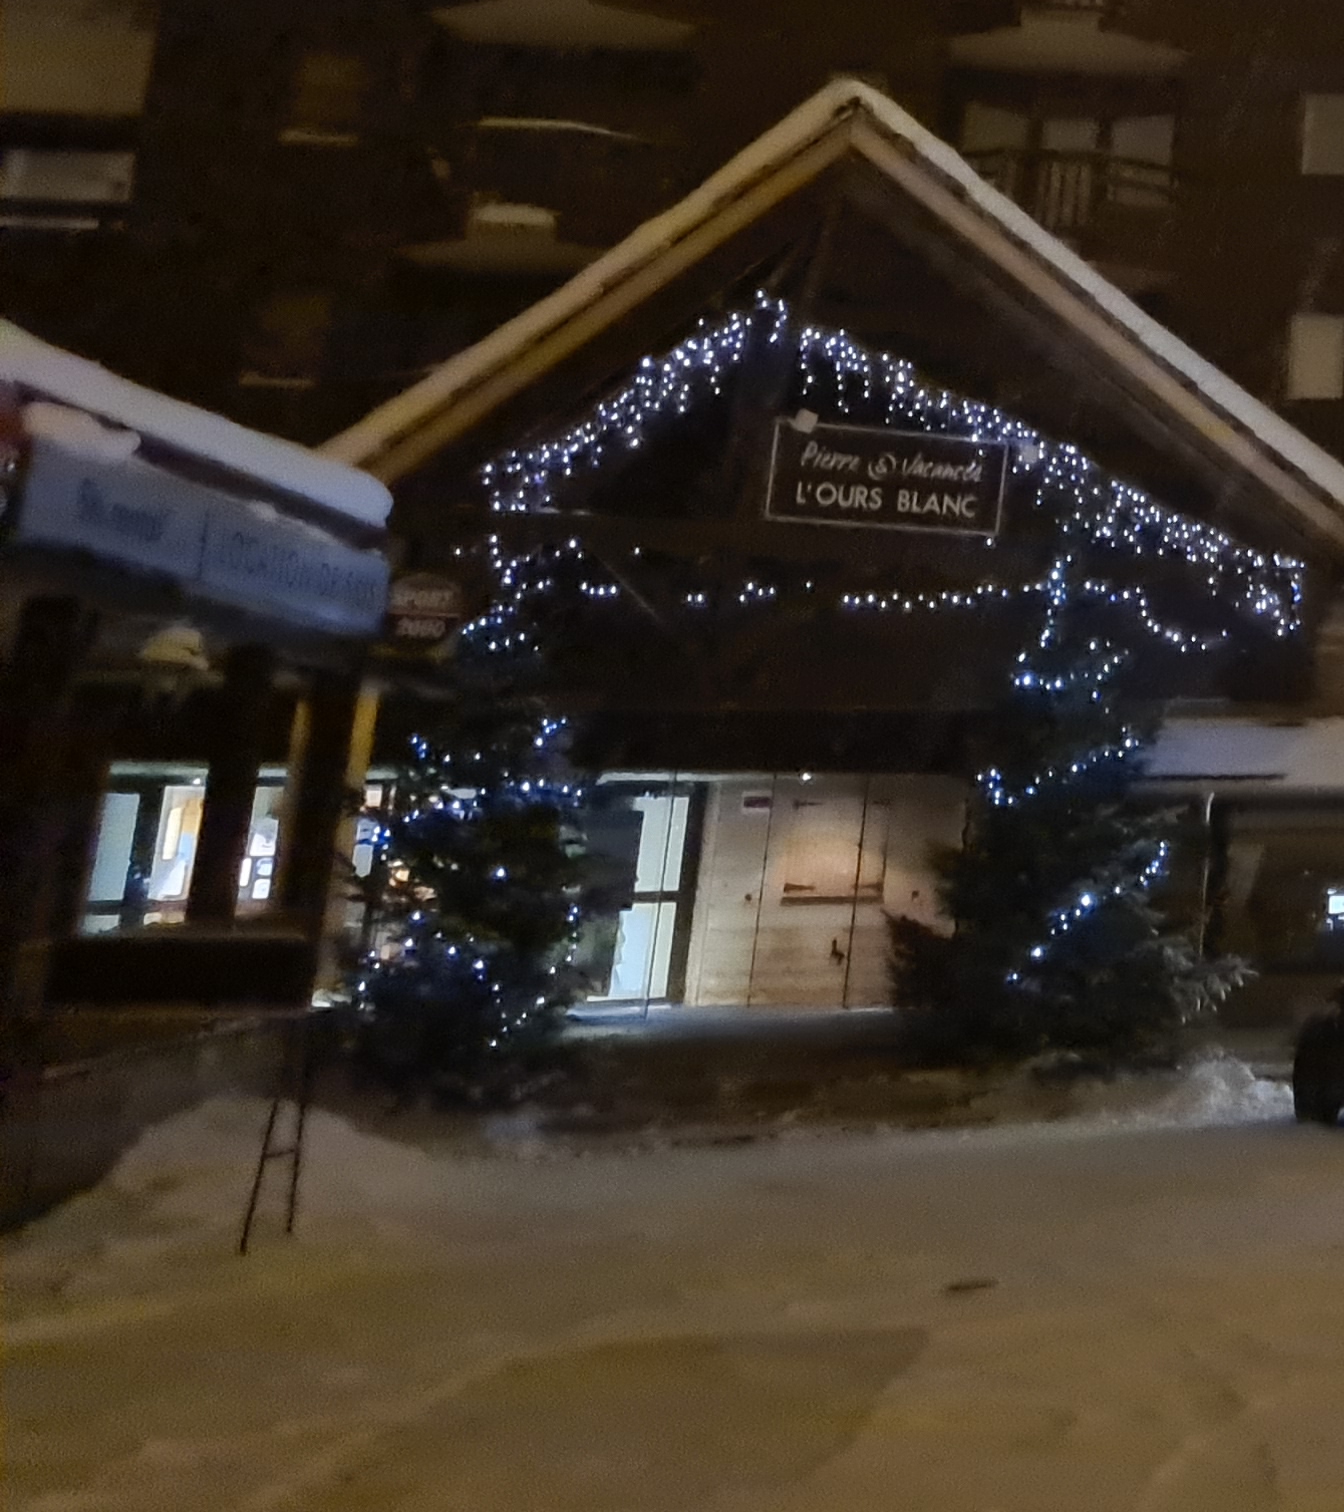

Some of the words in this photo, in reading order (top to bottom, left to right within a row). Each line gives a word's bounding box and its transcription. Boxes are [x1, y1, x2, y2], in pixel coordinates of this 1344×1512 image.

[801, 440, 861, 472] Pierre
[902, 451, 983, 483] Vacances
[796, 480, 882, 510] L'OURS
[897, 489, 978, 518] BLANC
